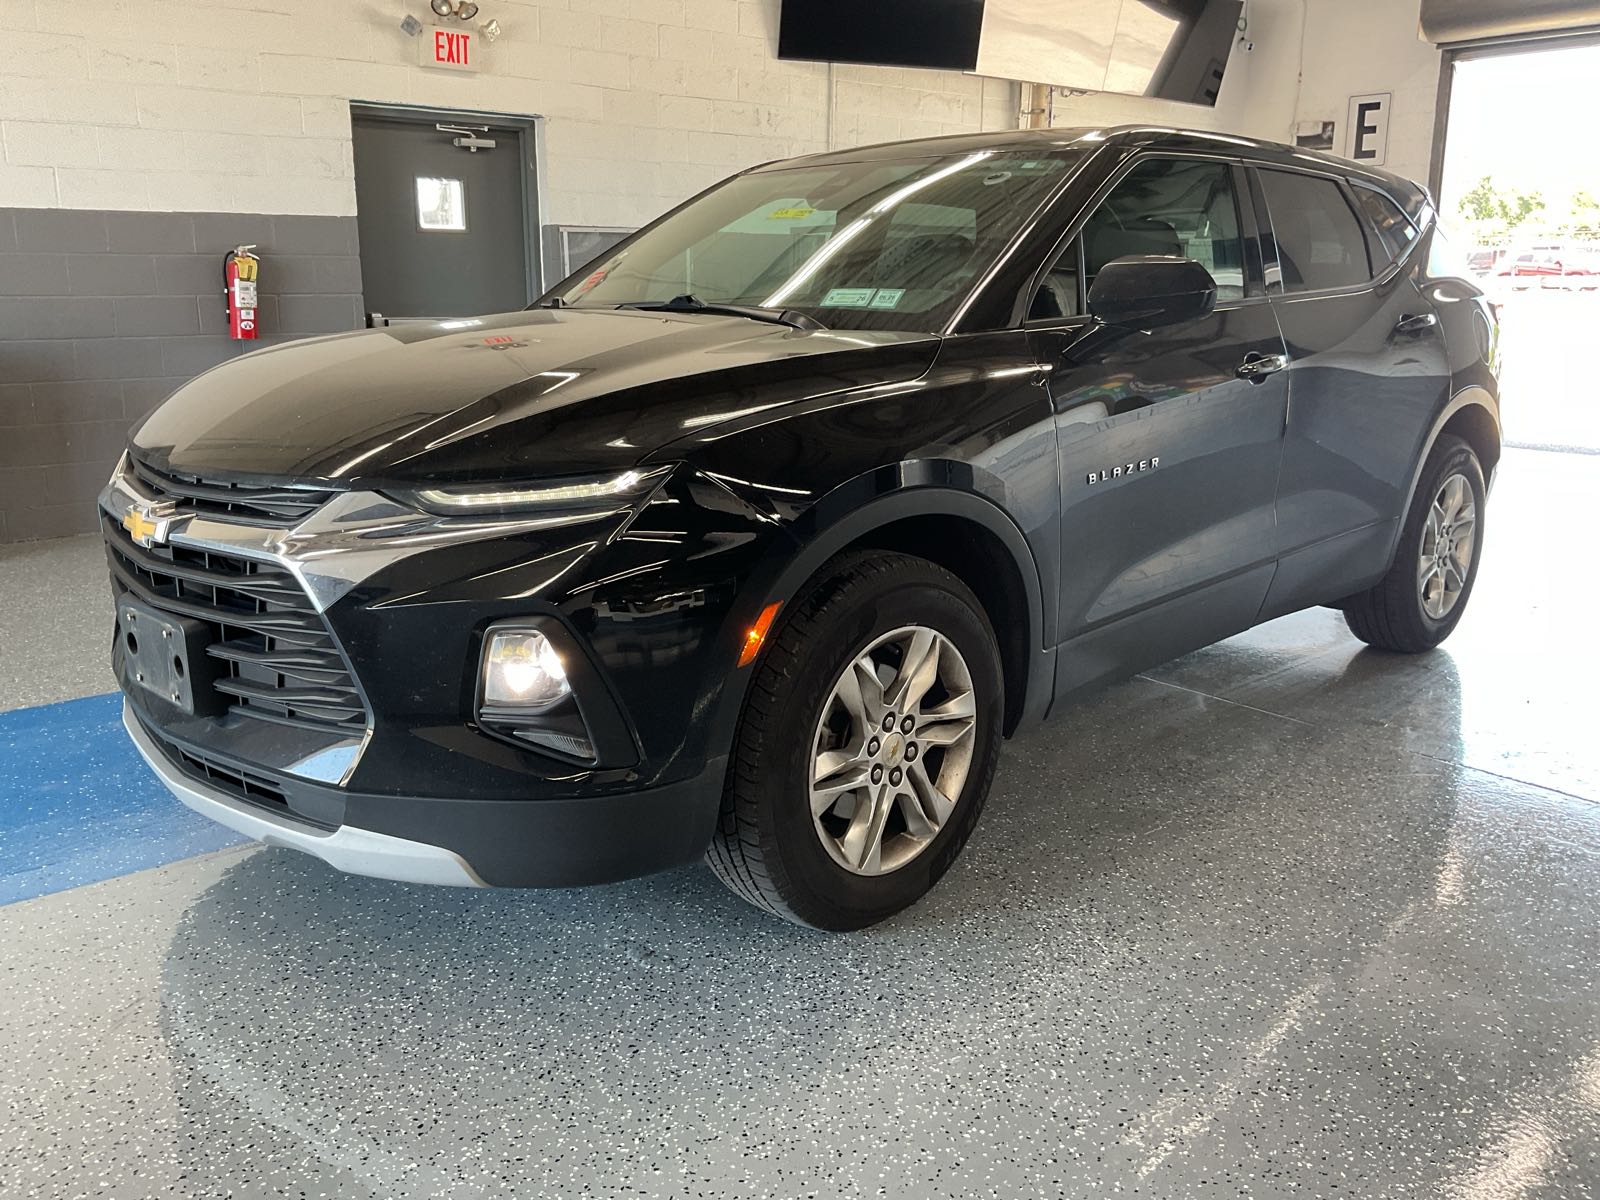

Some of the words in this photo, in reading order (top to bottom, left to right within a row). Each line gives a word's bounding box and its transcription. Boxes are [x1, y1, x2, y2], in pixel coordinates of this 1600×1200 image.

[435, 31, 470, 64] EXIT
[1354, 101, 1381, 159] E
[1086, 457, 1160, 485] BLAZER
